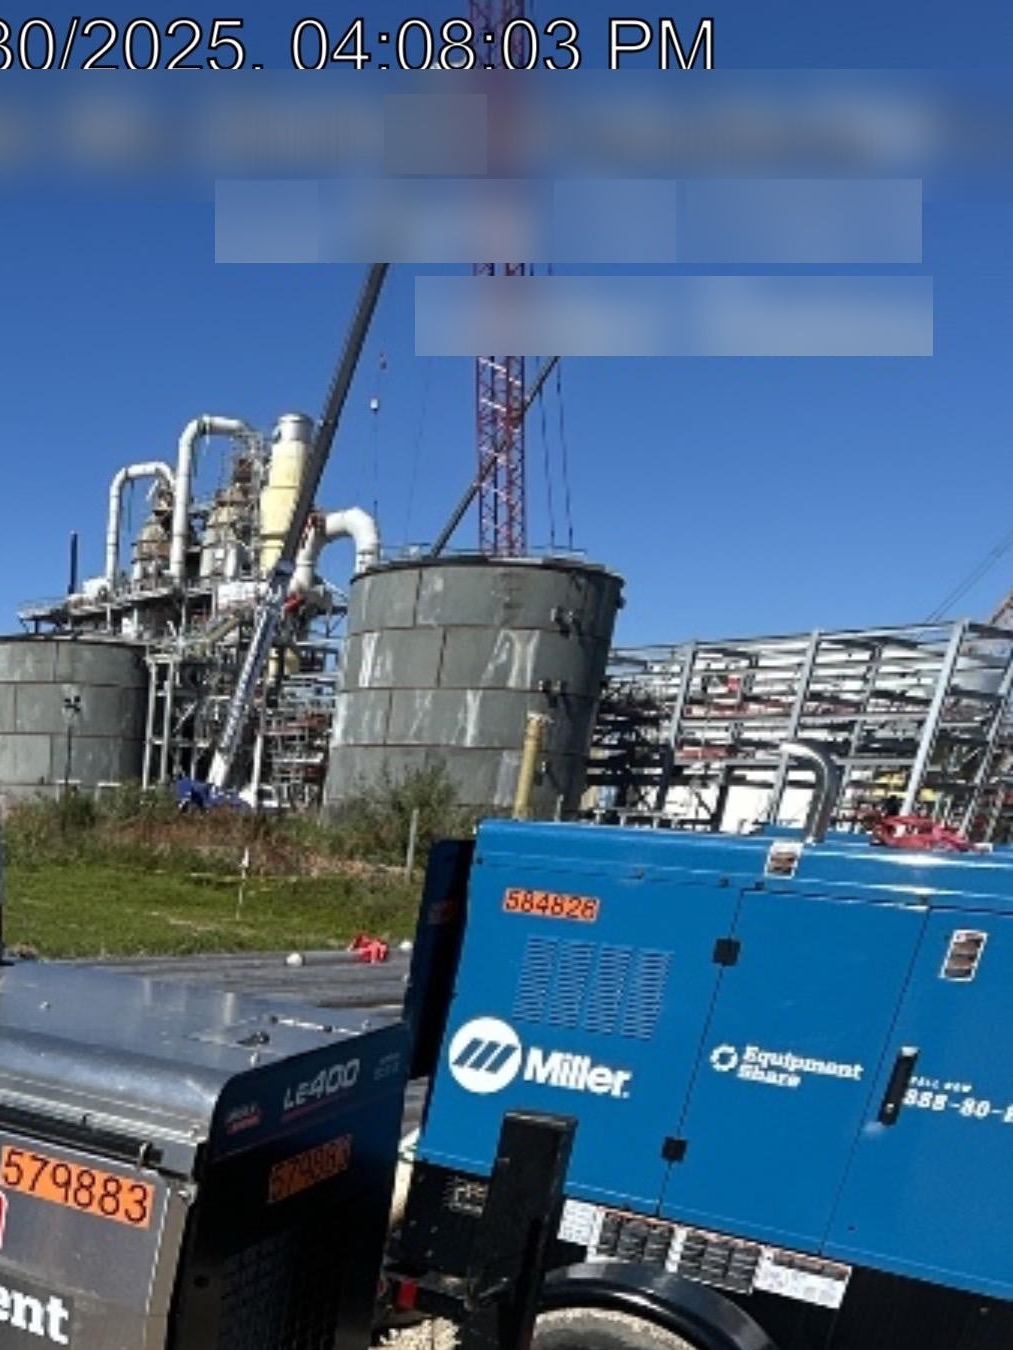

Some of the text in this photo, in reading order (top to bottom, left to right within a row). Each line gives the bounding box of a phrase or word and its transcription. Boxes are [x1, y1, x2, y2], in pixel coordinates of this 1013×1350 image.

[738, 1063, 801, 1089] Share
[743, 1045, 864, 1081] Equipment
[3, 1149, 149, 1224] 579883
